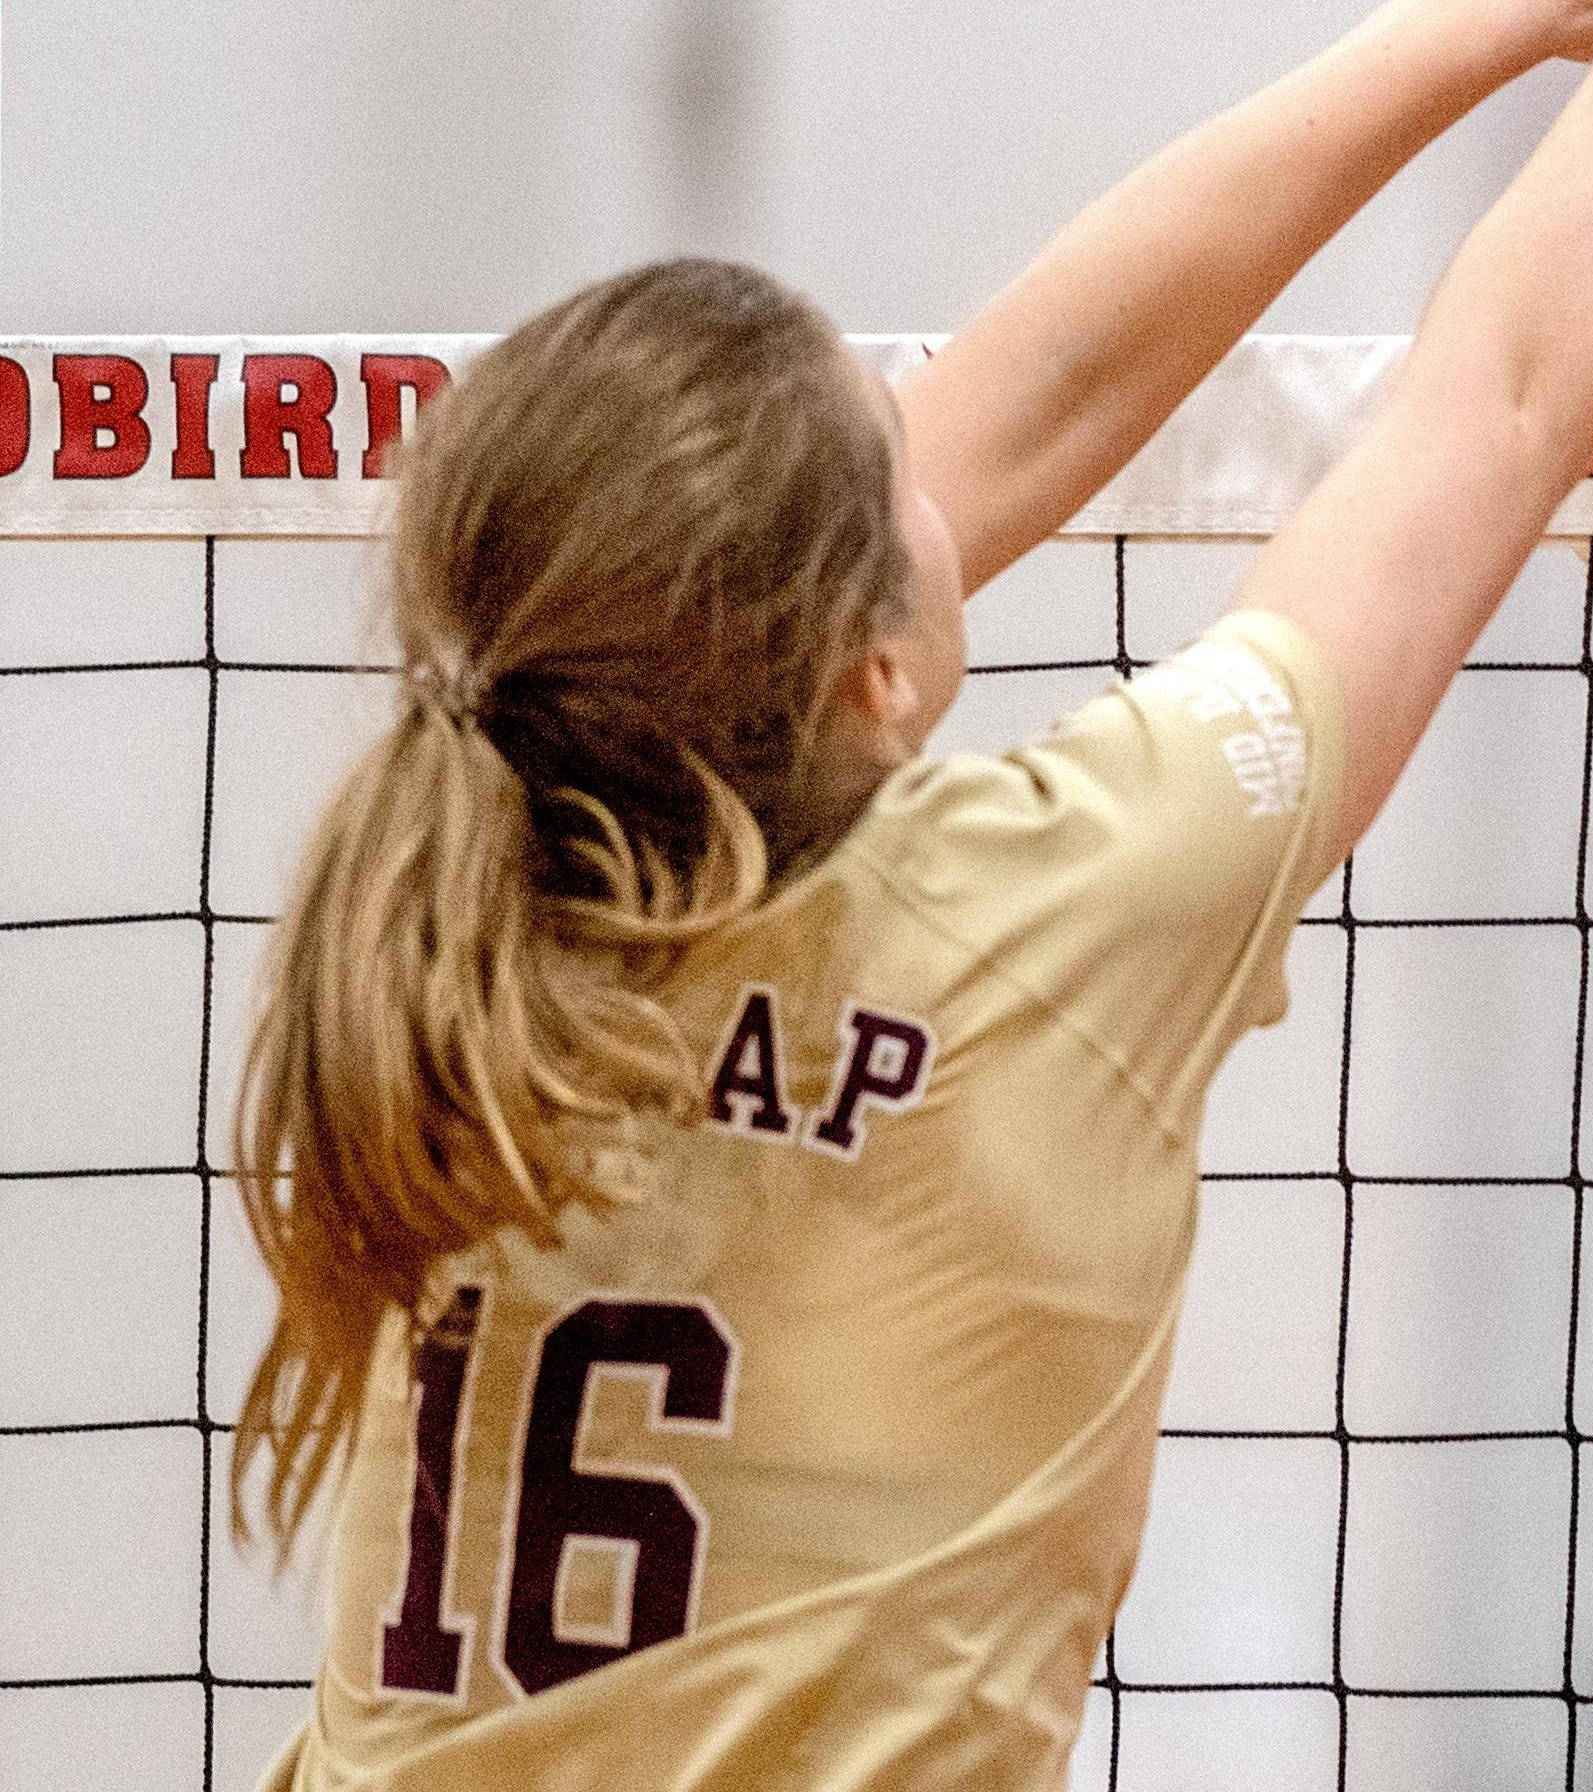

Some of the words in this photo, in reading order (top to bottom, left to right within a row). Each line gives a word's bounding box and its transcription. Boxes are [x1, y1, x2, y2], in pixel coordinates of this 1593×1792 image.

[0, 353, 453, 480] BIRD
[703, 983, 933, 1159] AP
[374, 1281, 738, 1704] 16
